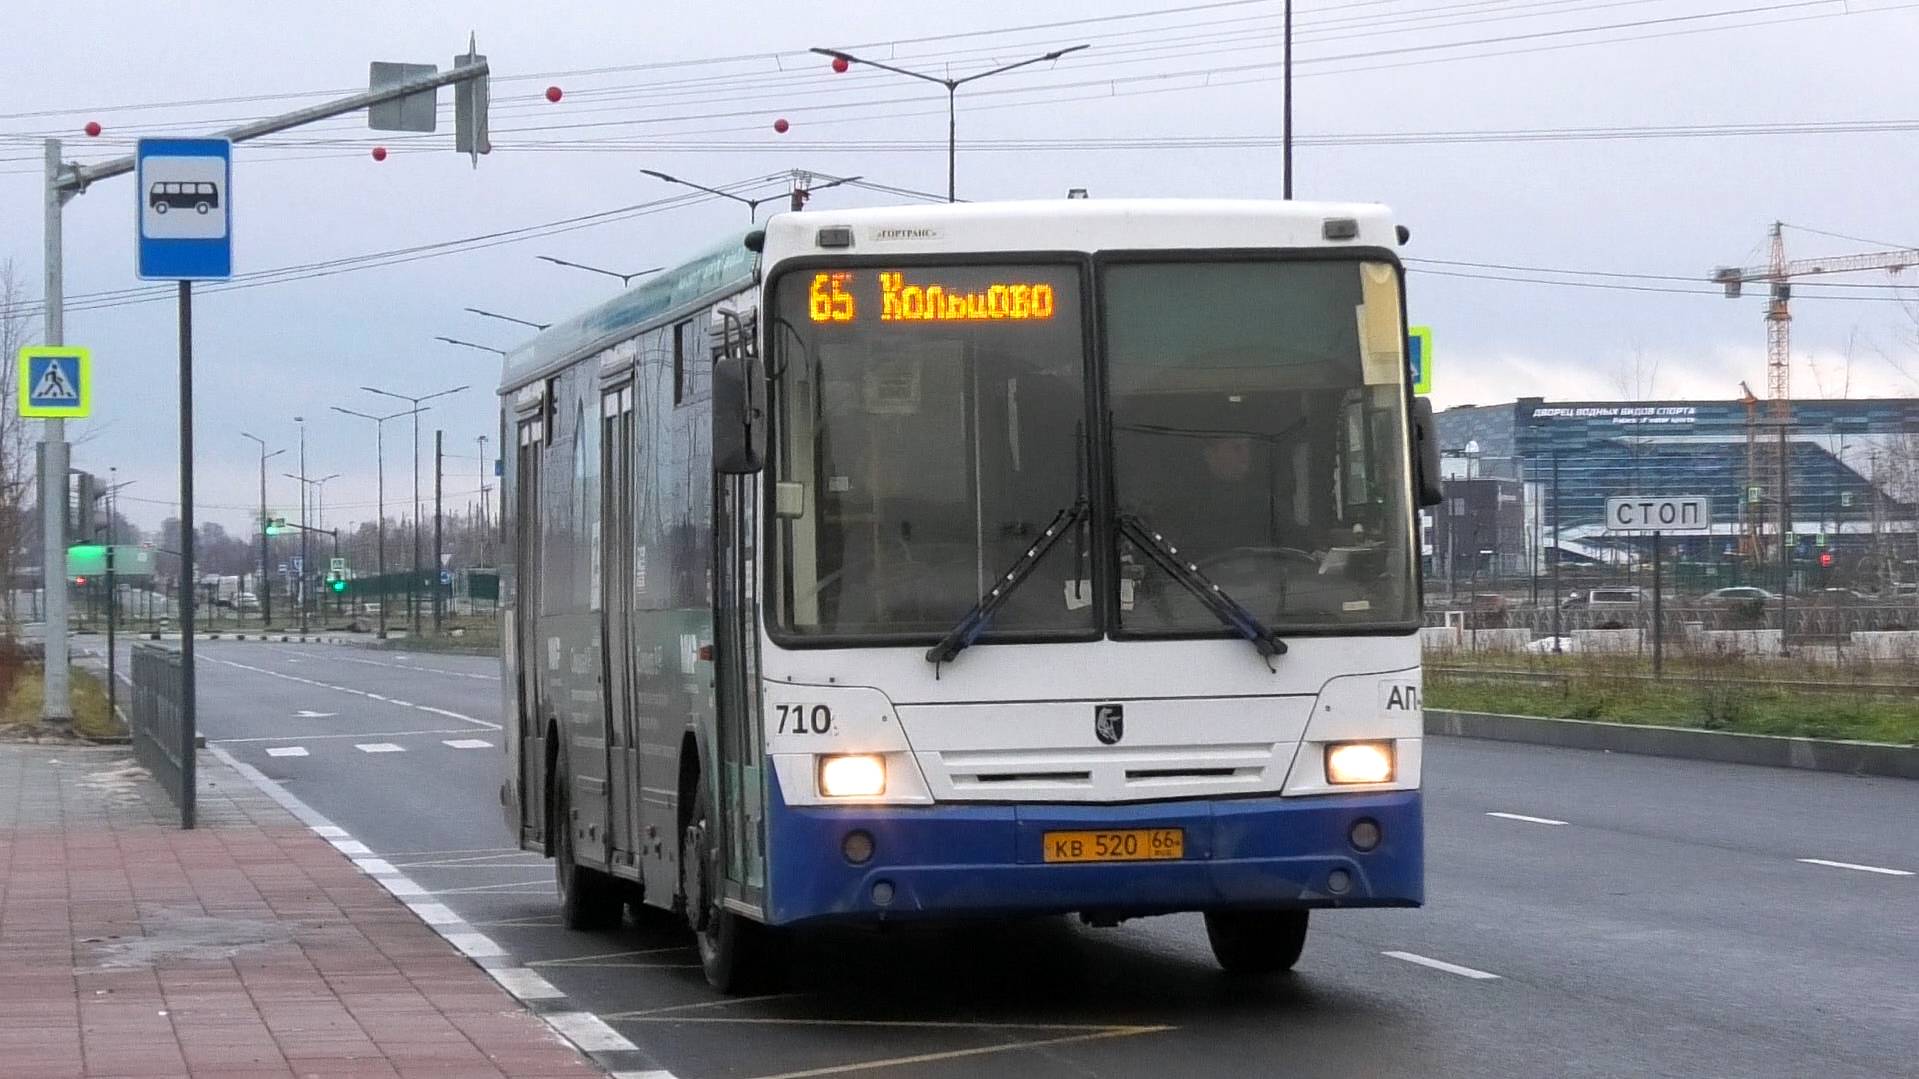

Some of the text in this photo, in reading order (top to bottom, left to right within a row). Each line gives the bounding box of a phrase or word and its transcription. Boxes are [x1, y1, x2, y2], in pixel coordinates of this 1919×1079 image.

[810, 271, 1054, 321] 65 Кольцово
[1532, 407, 1696, 417] ДВОРЕЦ ВОДНЫХ ВИДОВ СПОРТА
[1617, 502, 1697, 524] СТОП
[776, 704, 831, 734] 710
[1055, 831, 1174, 857] КВ 520 66
